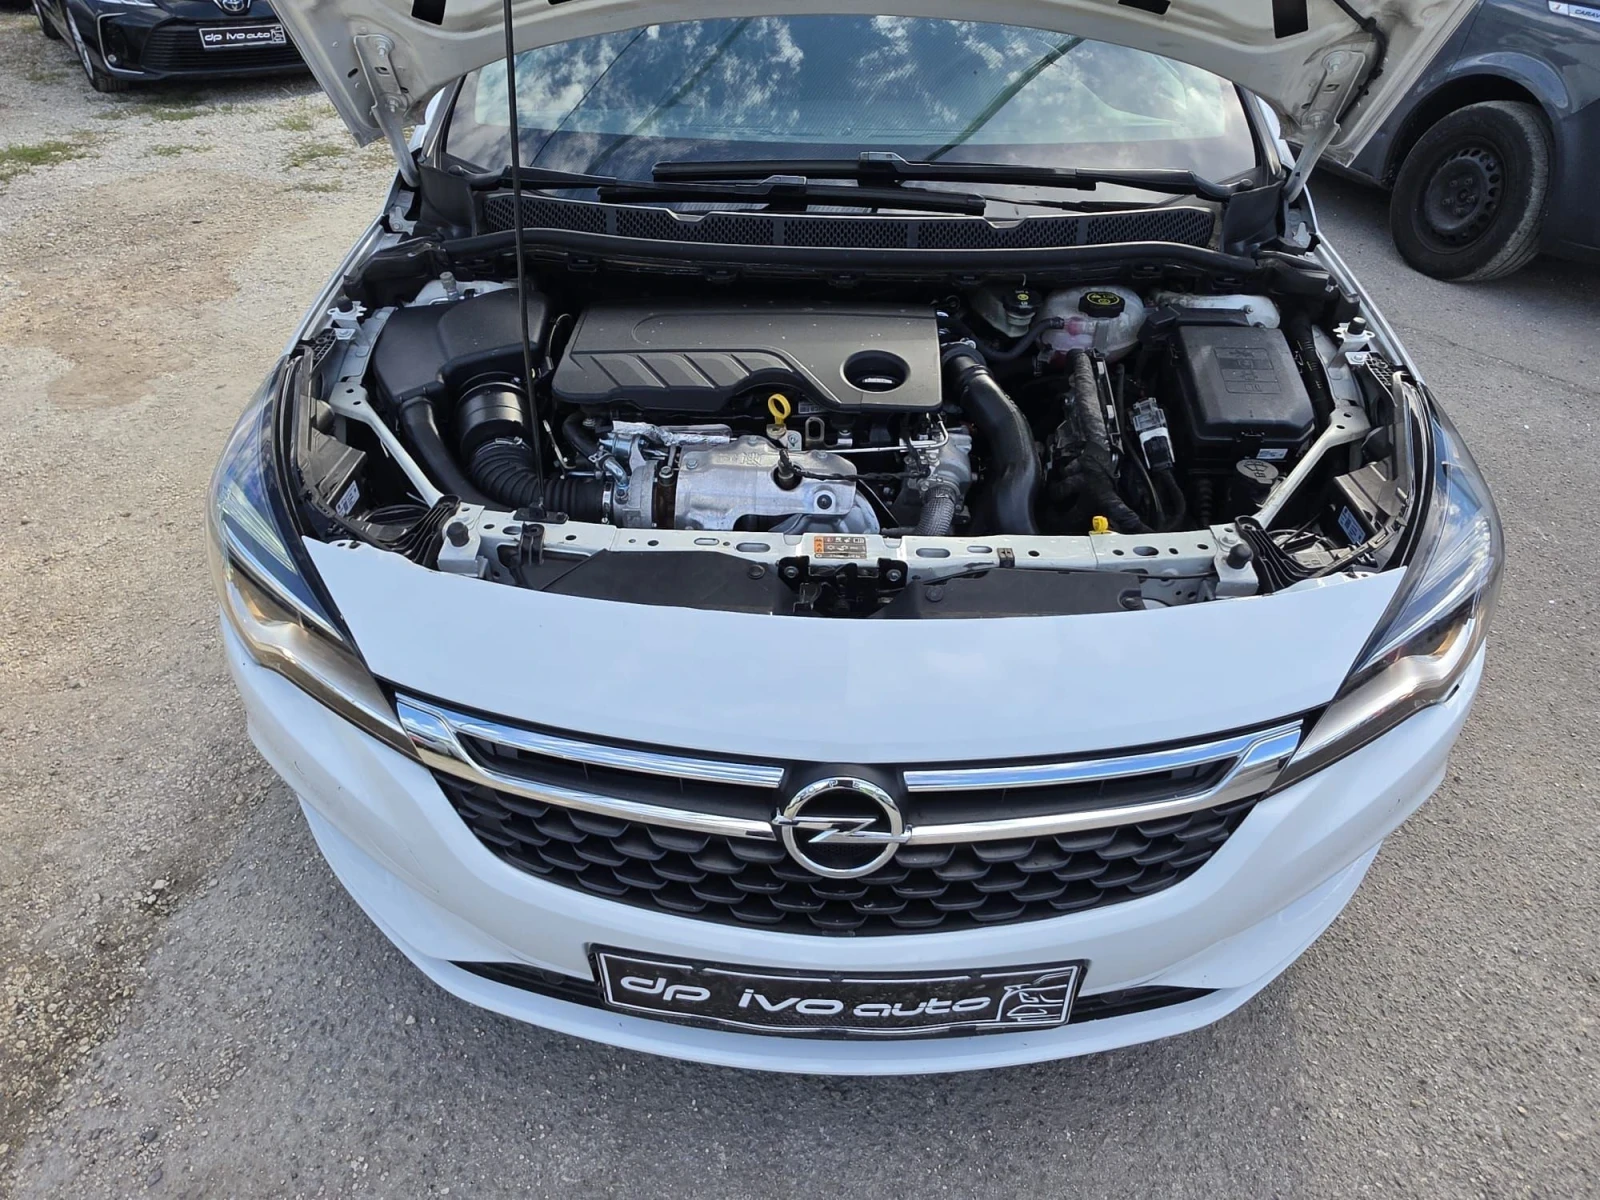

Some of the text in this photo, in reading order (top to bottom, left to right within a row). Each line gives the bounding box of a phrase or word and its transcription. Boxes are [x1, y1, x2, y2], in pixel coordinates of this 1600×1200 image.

[204, 33, 222, 42] dp
[226, 32, 245, 40] ivo
[620, 976, 991, 1017] dp ivo auto
